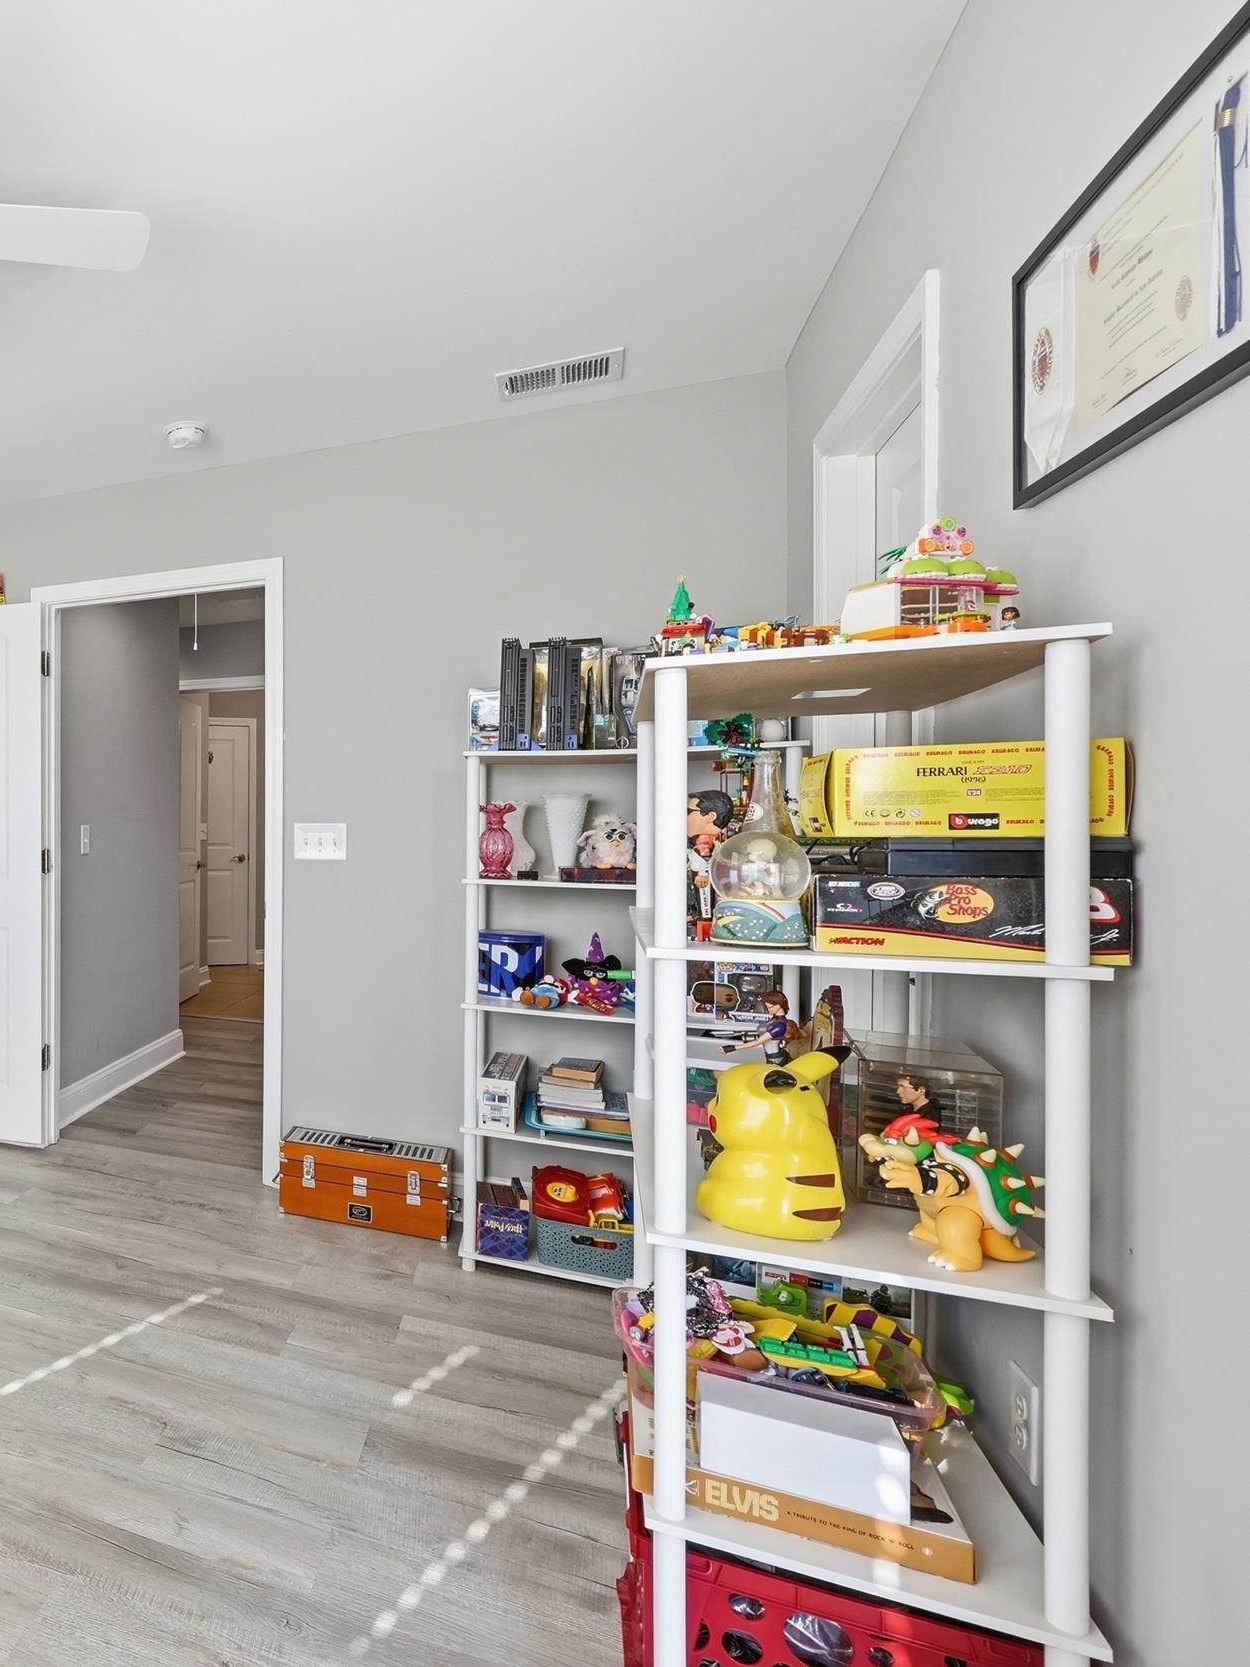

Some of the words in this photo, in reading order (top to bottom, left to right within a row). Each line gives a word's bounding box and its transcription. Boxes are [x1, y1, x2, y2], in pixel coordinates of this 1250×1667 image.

[916, 766, 968, 777] FERRARI
[945, 883, 978, 896] Bass
[945, 894, 972, 906] Pro
[946, 903, 990, 919] Shops
[704, 1478, 780, 1522] ELVIS
[792, 1512, 817, 1523] TRIBUTE
[819, 1518, 828, 1526] TO
